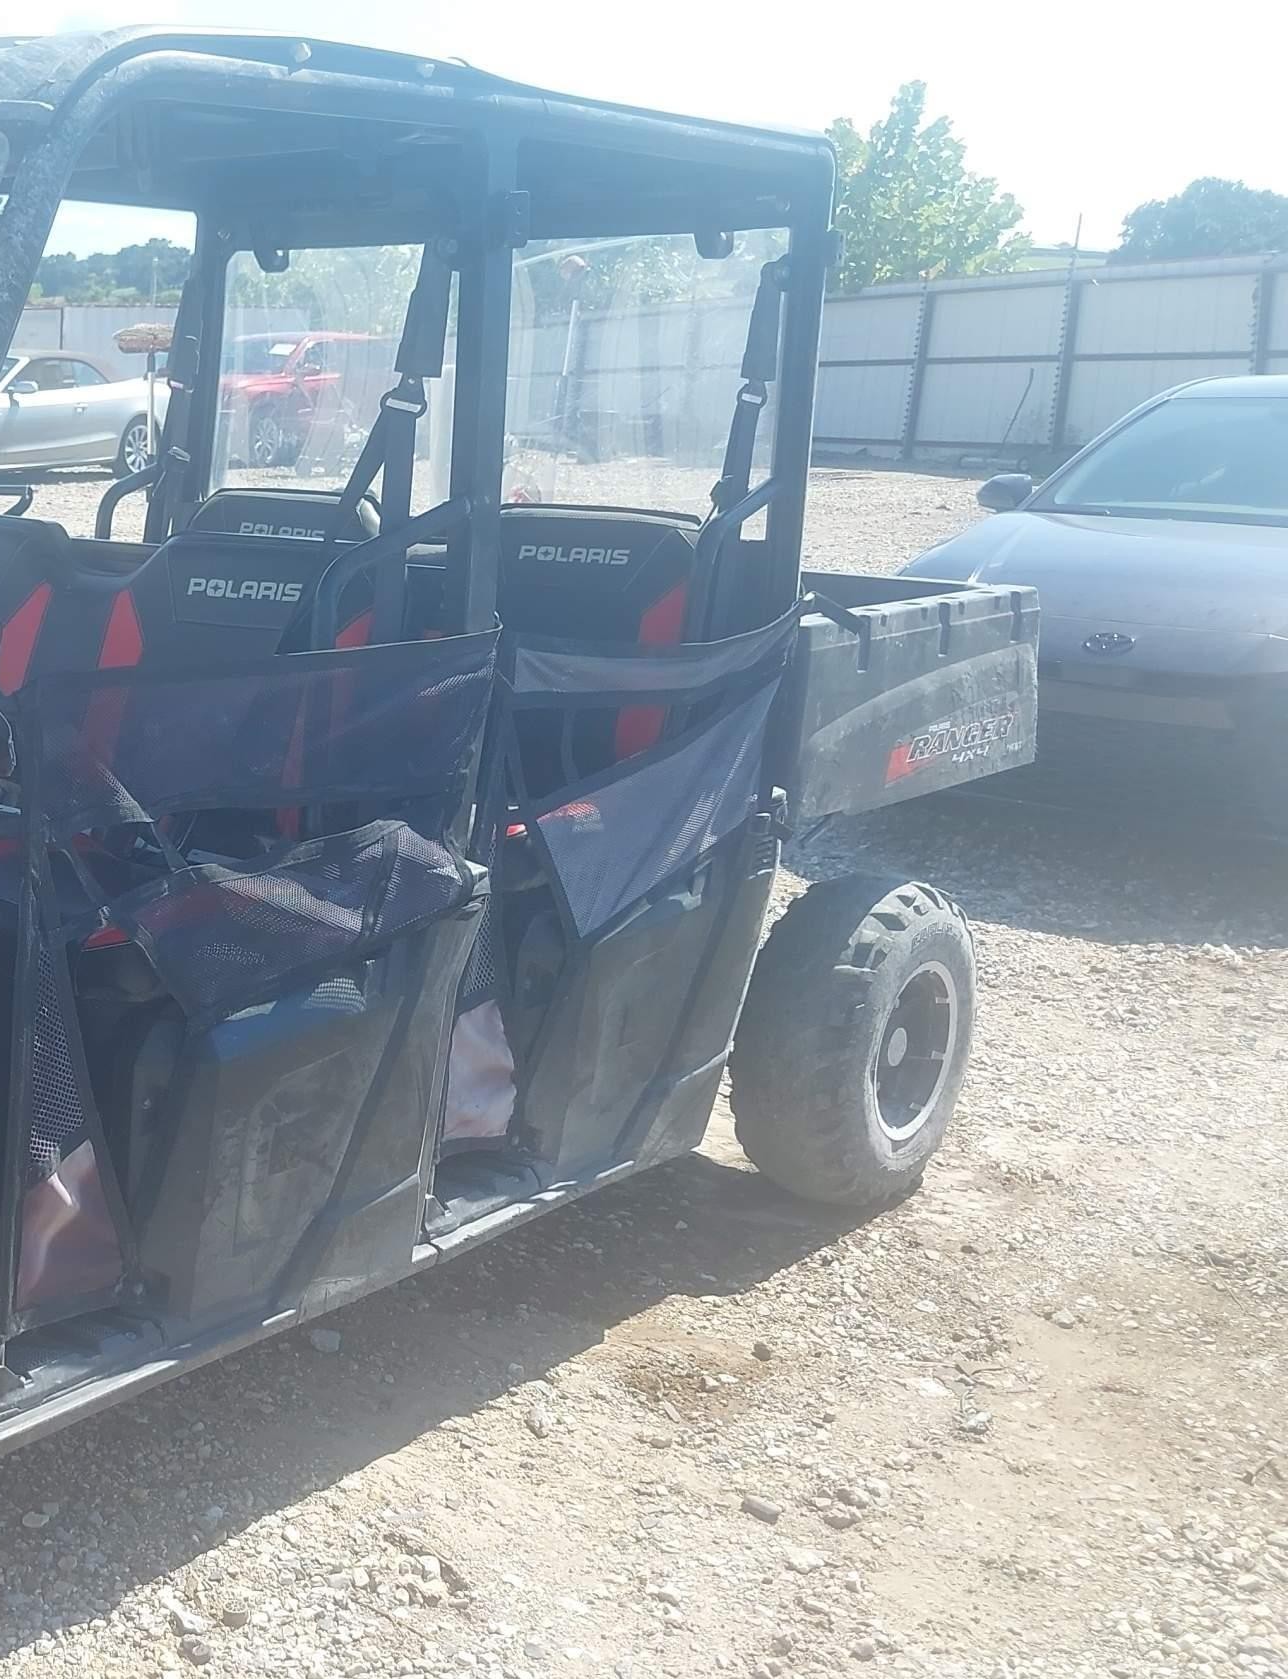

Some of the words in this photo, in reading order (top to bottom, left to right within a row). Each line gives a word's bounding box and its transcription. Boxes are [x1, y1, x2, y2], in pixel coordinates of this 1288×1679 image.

[518, 545, 630, 565] POLARIS
[187, 578, 303, 602] POLARIS
[906, 712, 1014, 763] RANGER
